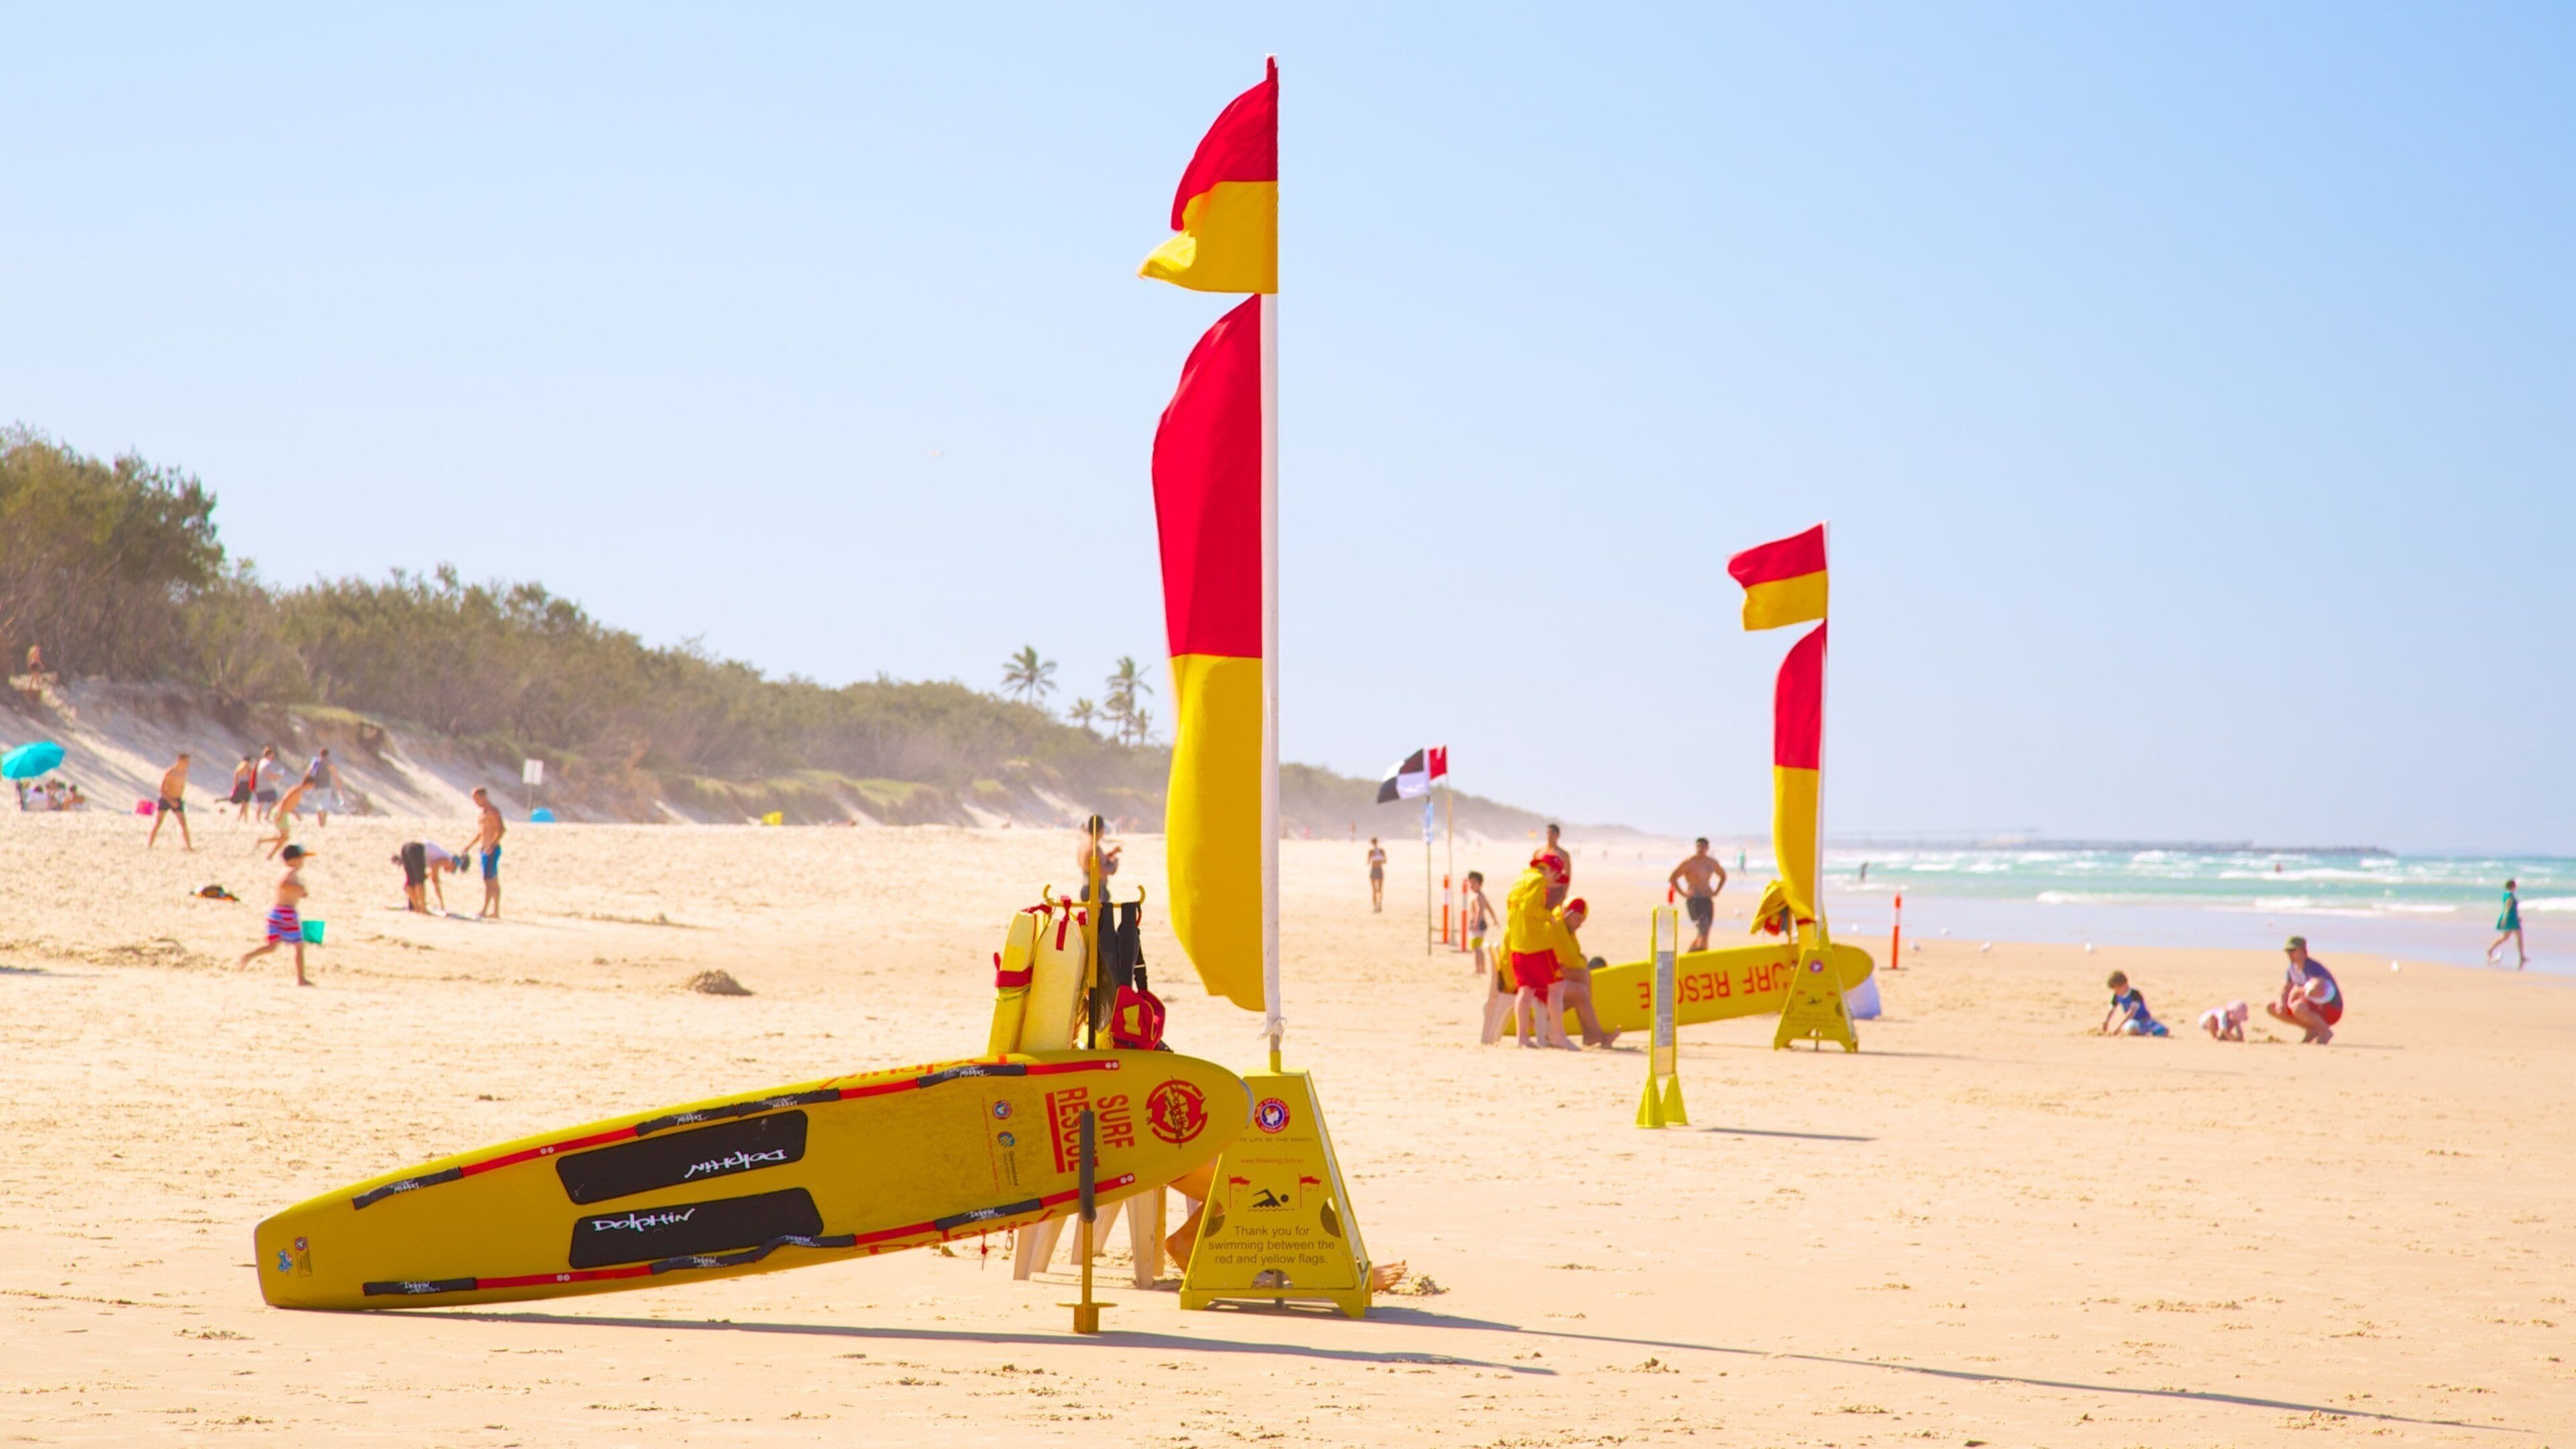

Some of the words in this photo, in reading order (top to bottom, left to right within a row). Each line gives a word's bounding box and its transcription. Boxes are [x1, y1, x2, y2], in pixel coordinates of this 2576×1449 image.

[1743, 963, 1788, 995] URF
[1637, 971, 1731, 1010] RESE
[1096, 1095, 1135, 1148] SURF
[1234, 1226, 1268, 1235] Thank
[1271, 1228, 1292, 1238] you
[1295, 1226, 1310, 1235] for
[1209, 1241, 1264, 1251] swimming
[1267, 1241, 1314, 1250] between
[1318, 1241, 1336, 1250] the
[1215, 1254, 1233, 1264] red
[1236, 1254, 1257, 1264] and
[1260, 1254, 1295, 1265] yellow
[1299, 1254, 1328, 1265] flags.
